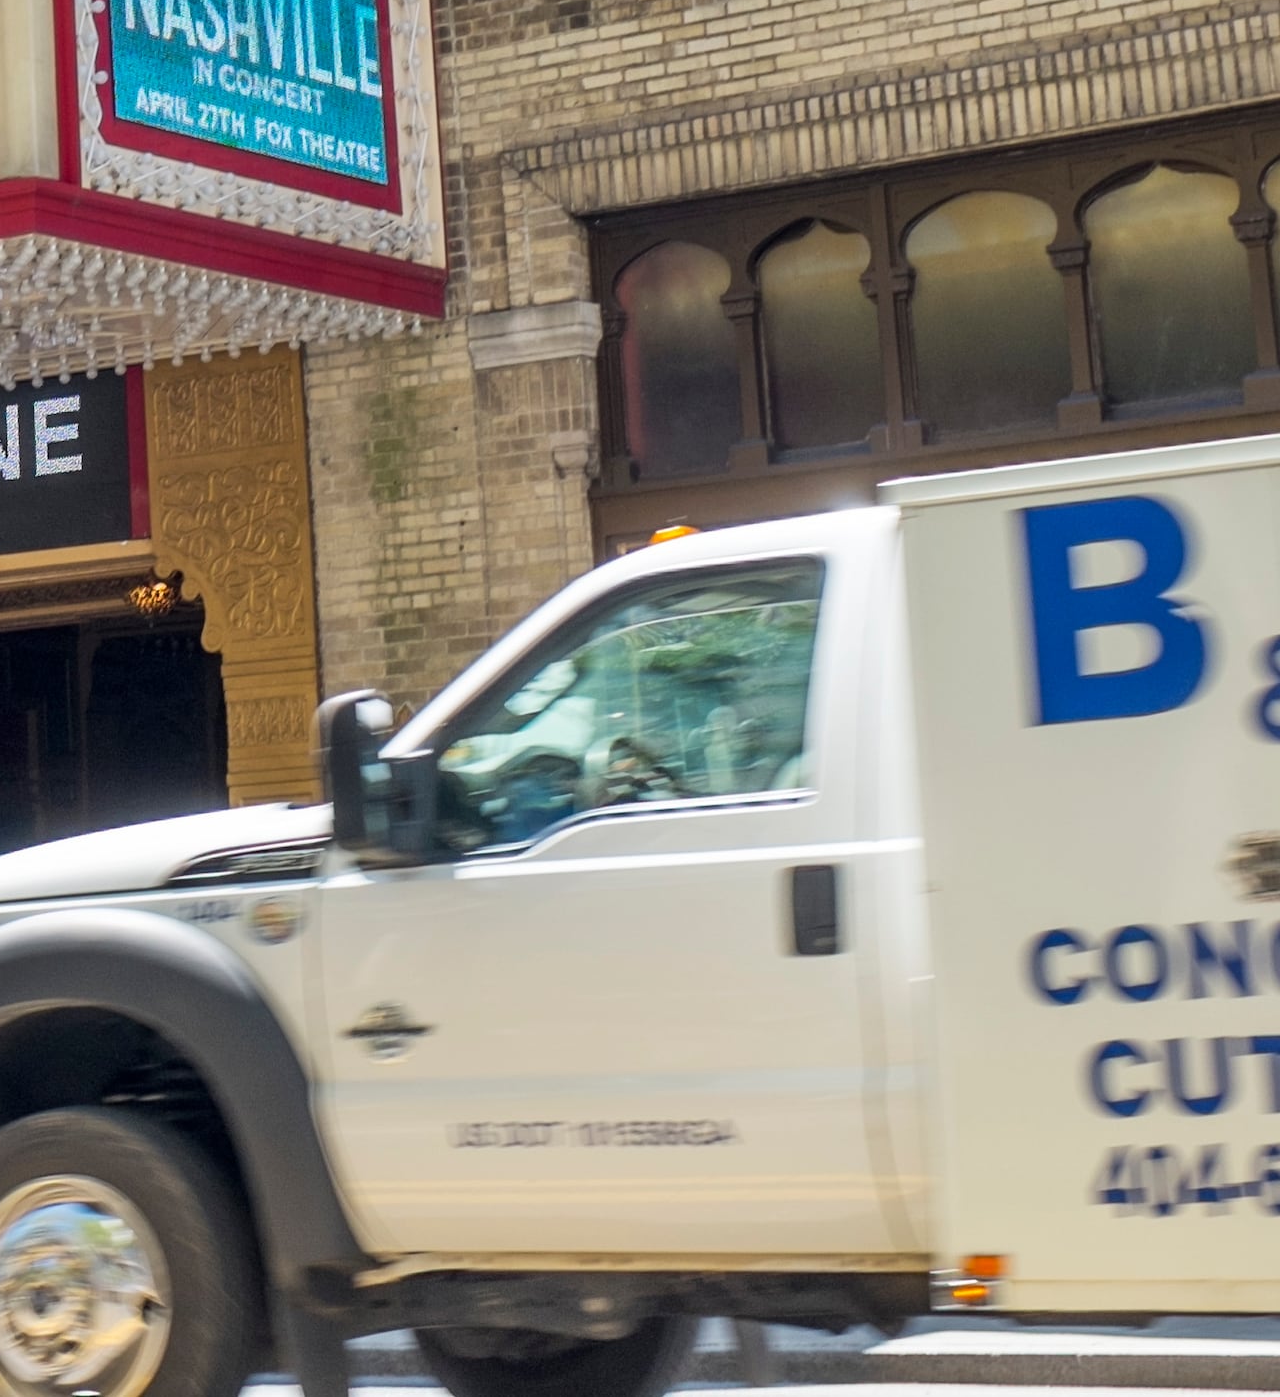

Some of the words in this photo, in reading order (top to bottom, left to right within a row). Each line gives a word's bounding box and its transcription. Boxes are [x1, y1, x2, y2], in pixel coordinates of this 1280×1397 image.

[192, 57, 214, 87] IN
[218, 63, 325, 116] CONCERT
[136, 87, 194, 126] APRIL
[197, 104, 246, 138] 27TH
[254, 116, 294, 149] FOX
[298, 127, 381, 173] THEATRE
[1014, 493, 1216, 726] B
[1025, 920, 1280, 1005] CON
